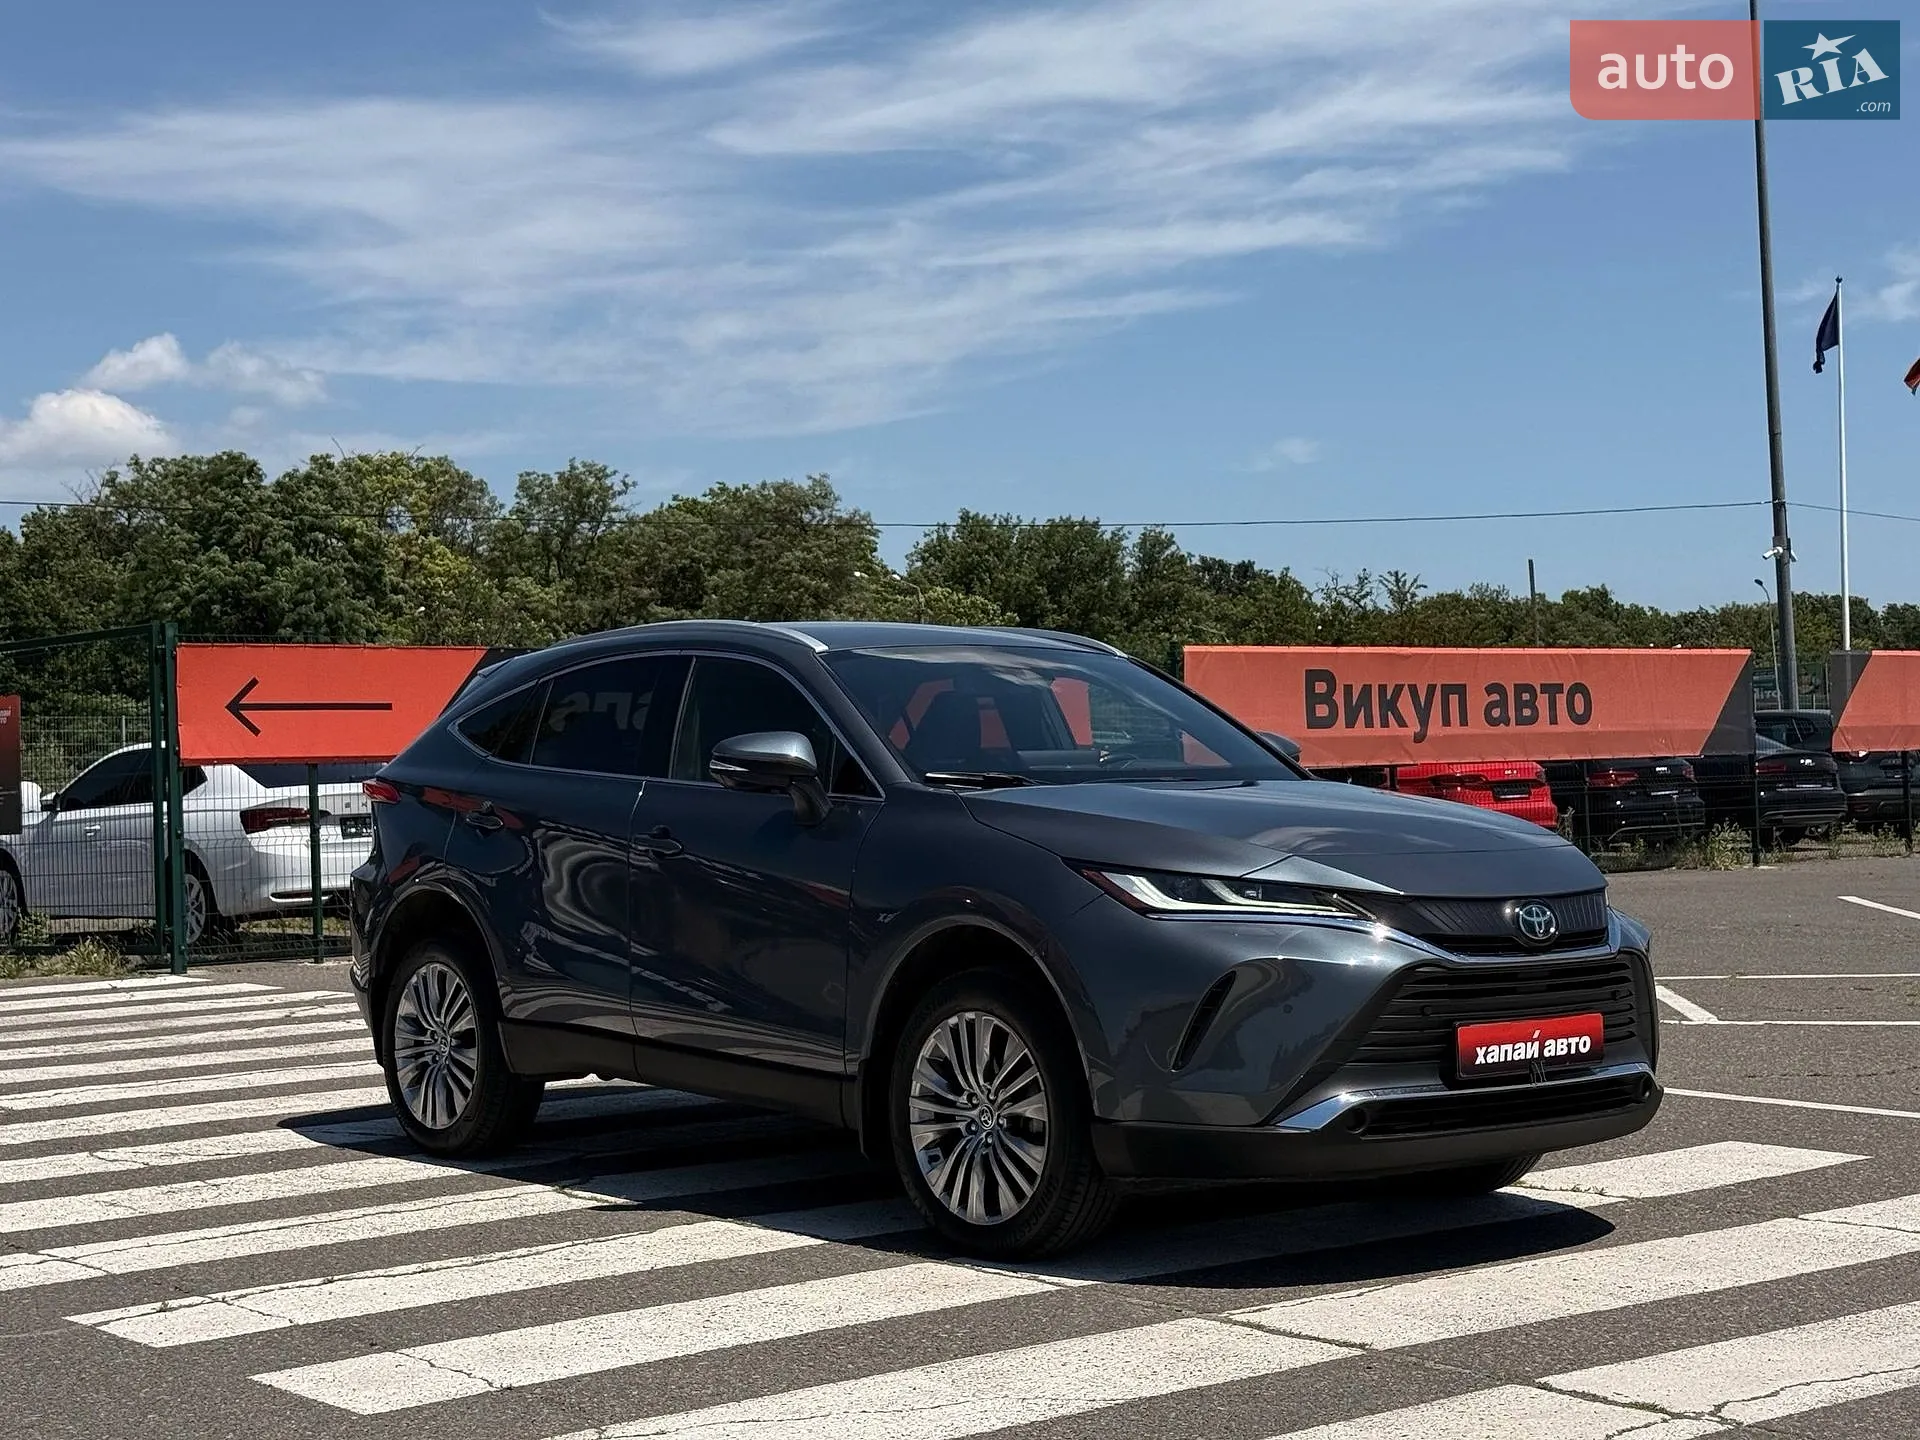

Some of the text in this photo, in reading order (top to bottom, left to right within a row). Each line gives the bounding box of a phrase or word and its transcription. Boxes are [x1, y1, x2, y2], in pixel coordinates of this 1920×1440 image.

[1305, 669, 1592, 743] Викуп авто
[1543, 1035, 1591, 1058] авто
